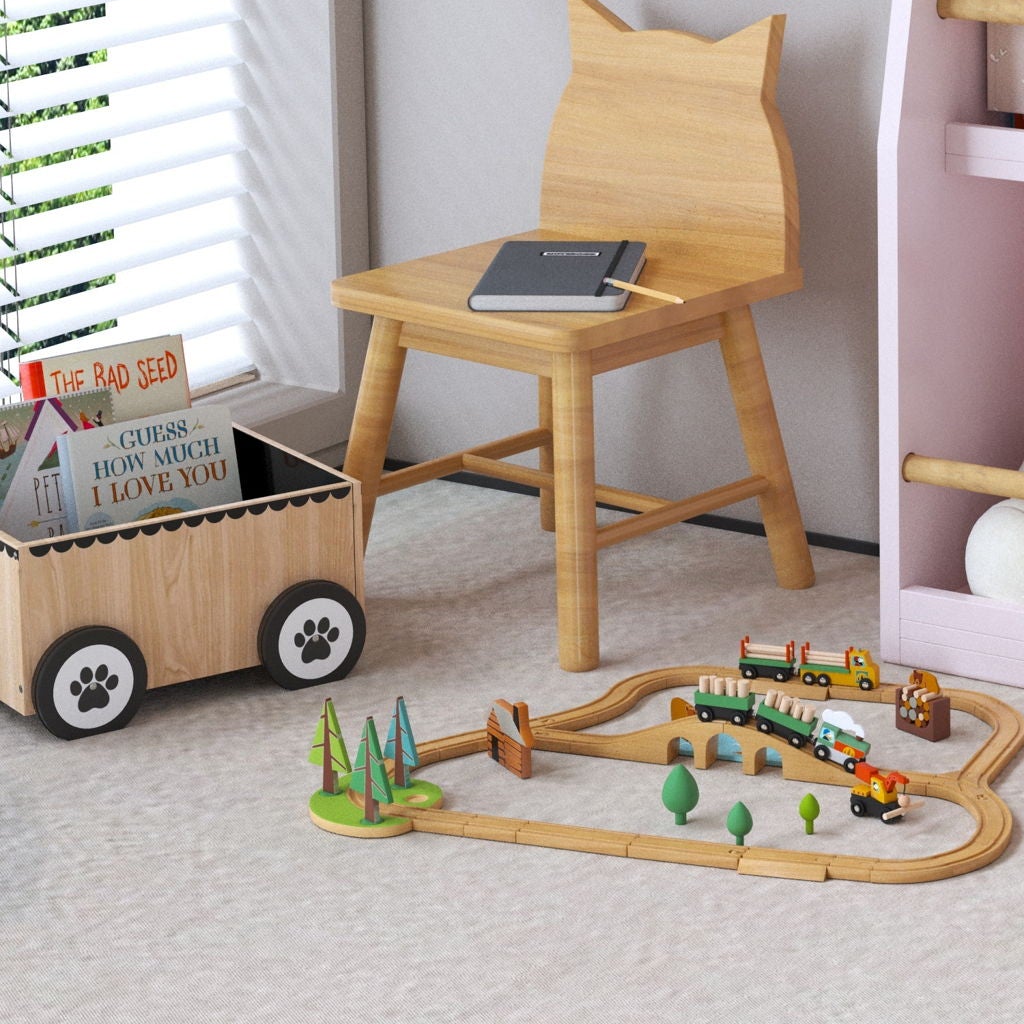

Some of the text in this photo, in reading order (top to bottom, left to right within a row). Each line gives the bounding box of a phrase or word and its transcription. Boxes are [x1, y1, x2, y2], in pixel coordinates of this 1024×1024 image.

[136, 350, 178, 390] SEED
[119, 419, 188, 450] GUESS
[93, 436, 221, 480] HOW MUCH
[92, 459, 228, 507] I LOVE YOU
